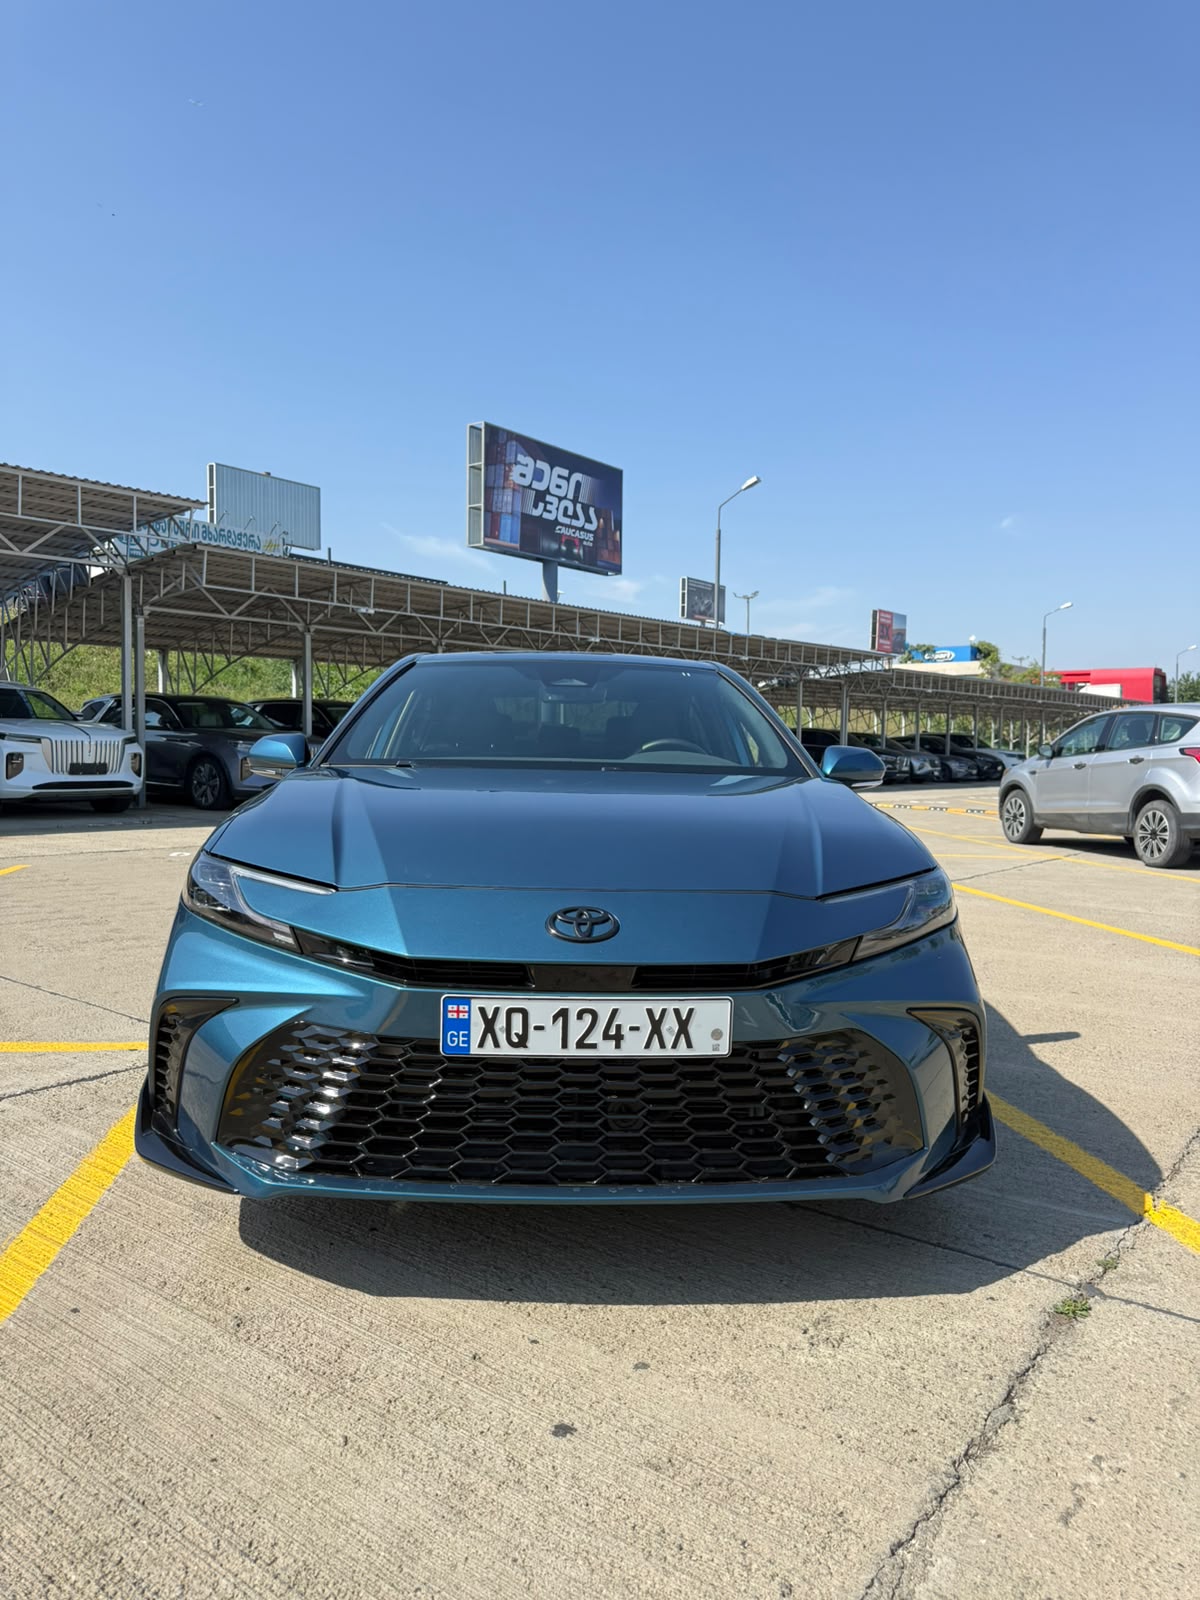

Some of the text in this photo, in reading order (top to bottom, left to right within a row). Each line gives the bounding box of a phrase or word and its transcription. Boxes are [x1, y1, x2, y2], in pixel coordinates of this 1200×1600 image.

[513, 454, 590, 503] შენი
[555, 526, 594, 541] CAUCASUS
[446, 1030, 469, 1047] GE
[477, 1006, 695, 1050] XQ-124-XX
